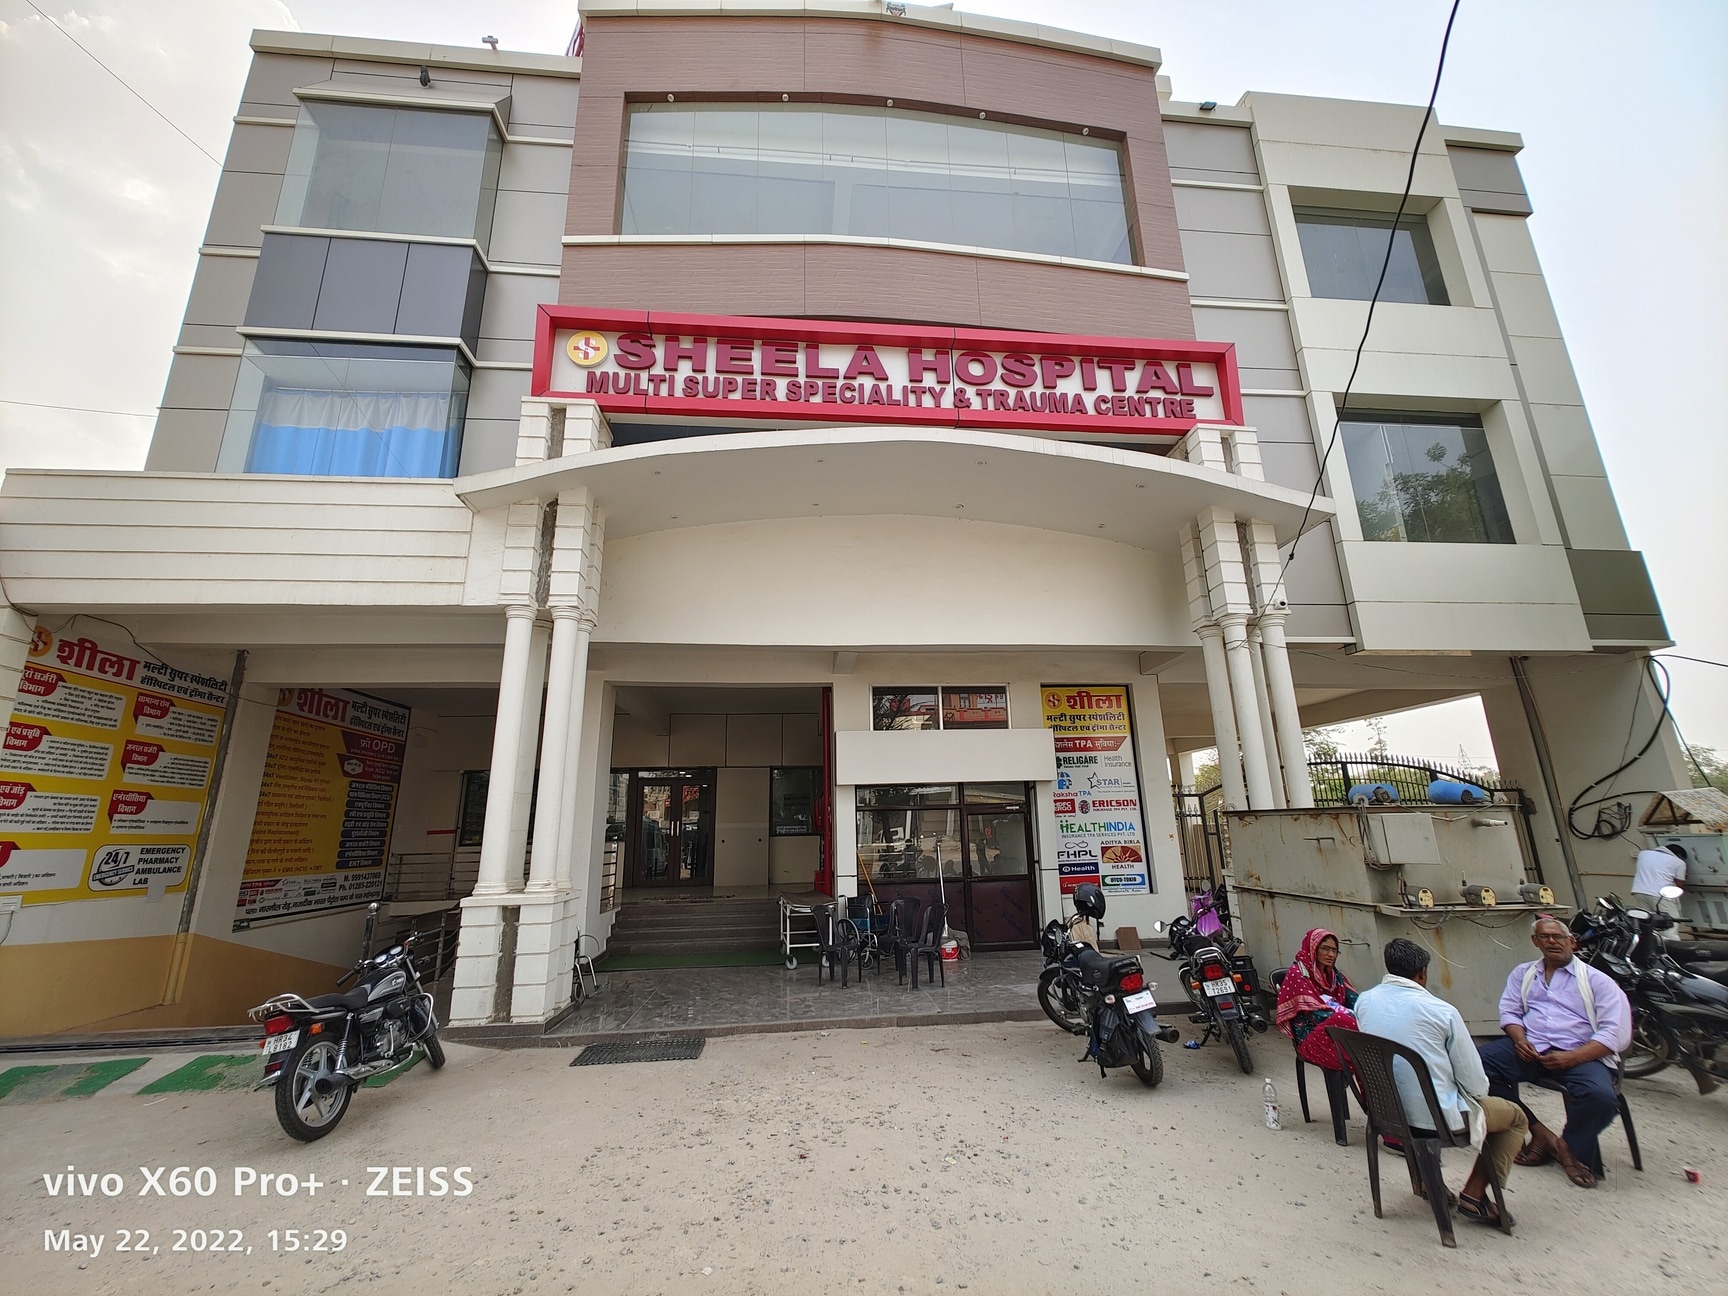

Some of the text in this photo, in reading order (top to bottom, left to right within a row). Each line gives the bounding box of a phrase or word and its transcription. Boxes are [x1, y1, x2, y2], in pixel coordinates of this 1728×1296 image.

[613, 331, 1214, 397] SHEELA HOSPITAL
[585, 370, 1197, 420] MULTI SUPER SPECIALITY & TRAUMA CENTRE
[56, 637, 141, 682] शीला
[143, 660, 168, 676] मल्टी
[34, 672, 57, 684] सर्जरी
[19, 680, 46, 694] विभाग
[140, 675, 175, 692] हॉस्पिटल
[176, 685, 190, 696] एवं
[1065, 690, 1123, 710] शीला
[143, 705, 162, 717] विभाग
[1046, 712, 1067, 722] मल्टी
[1069, 713, 1087, 724] सुपर
[1080, 723, 1091, 731] एवं
[6, 736, 28, 748] विभाग
[372, 739, 396, 753] OPD
[1074, 740, 1093, 748] TPA
[1062, 755, 1099, 765] RELIGARE
[1096, 778, 1121, 787] STAR
[1091, 798, 1137, 808] ERICSON
[140, 847, 187, 856] EMERGENCY
[1057, 849, 1098, 860] FHPL
[103, 851, 130, 866] 24/7
[137, 857, 181, 865] PHARMACY
[135, 866, 182, 876] AMBULANCE
[1071, 864, 1096, 872] Health
[133, 877, 149, 886] LAB
[1211, 979, 1228, 988] HR35
